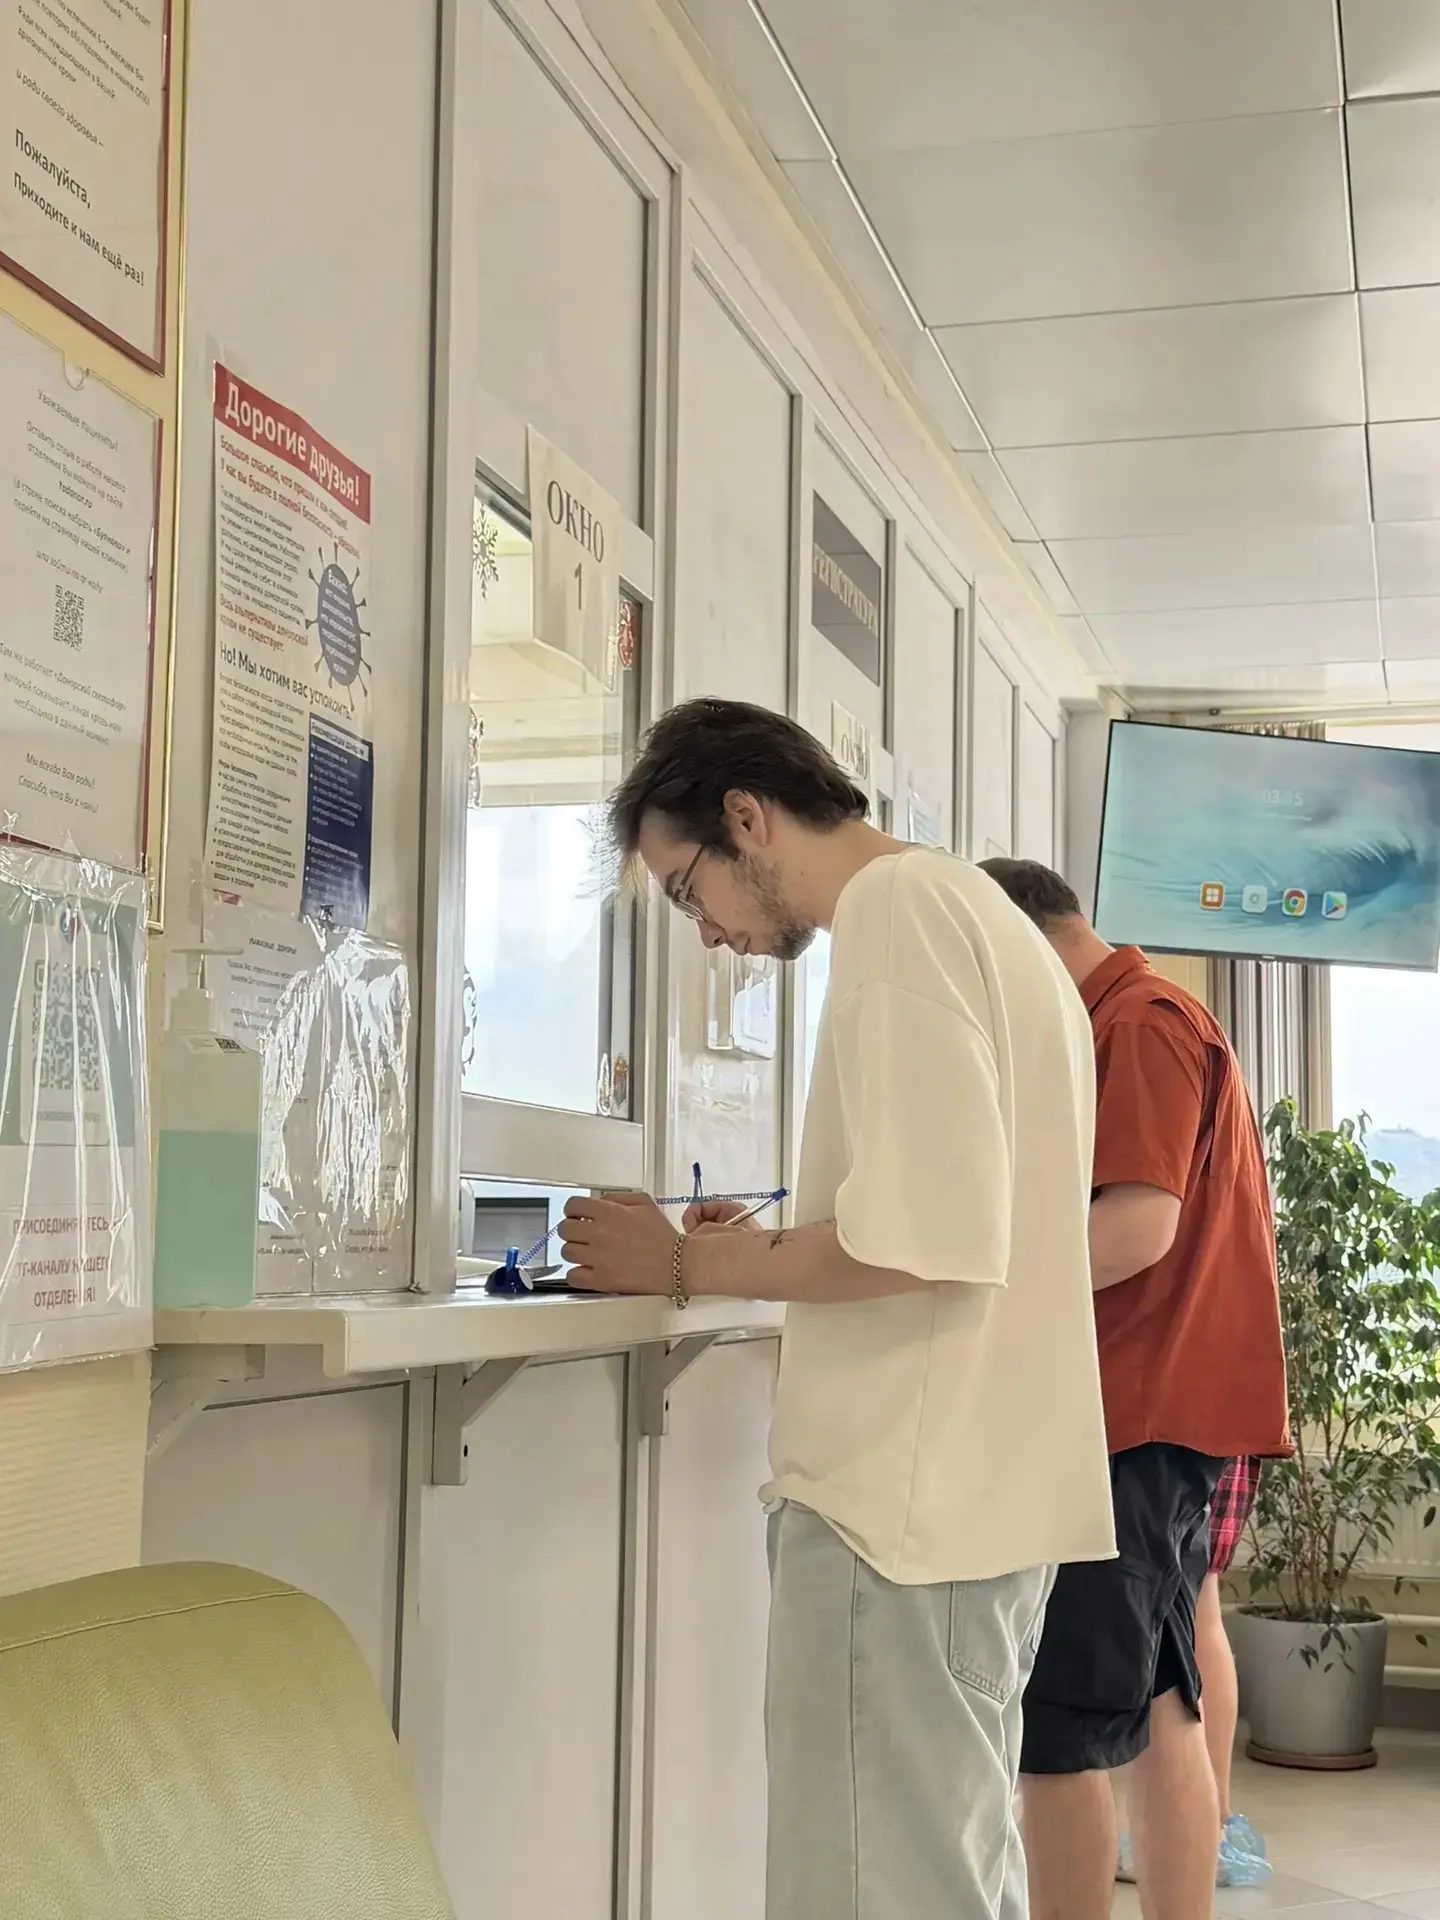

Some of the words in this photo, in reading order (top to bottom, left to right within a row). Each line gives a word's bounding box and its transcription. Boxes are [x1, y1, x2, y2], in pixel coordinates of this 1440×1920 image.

[18, 5, 34, 26] Ради
[22, 75, 41, 95] ради
[41, 91, 65, 117] своего
[66, 113, 97, 144] здоровья
[15, 129, 90, 208] Пожалуйста,
[14, 172, 69, 229] Приходите
[79, 229, 100, 253] нам
[102, 246, 122, 270] ещё
[125, 263, 144, 286] раз!
[38, 389, 80, 427] Уважаемые
[81, 421, 118, 452] пациенты!
[224, 383, 307, 461] Дорогие
[309, 446, 359, 505] друзья!
[28, 443, 61, 470] отделения
[81, 459, 102, 479] работе
[103, 475, 126, 493] нашего
[547, 480, 605, 563] ОКНО
[574, 562, 583, 611] 1
[220, 641, 236, 666] Но!
[239, 651, 257, 675] Мы
[259, 665, 290, 690] хотим
[293, 680, 308, 699] вас
[13, 1216, 109, 1236] ПРИСОЕДИНЯТЕСЬ
[17, 1258, 73, 1277] ТГ-КАНАЛУ
[34, 1286, 96, 1310] ОТДЕЛЕНЯ!
